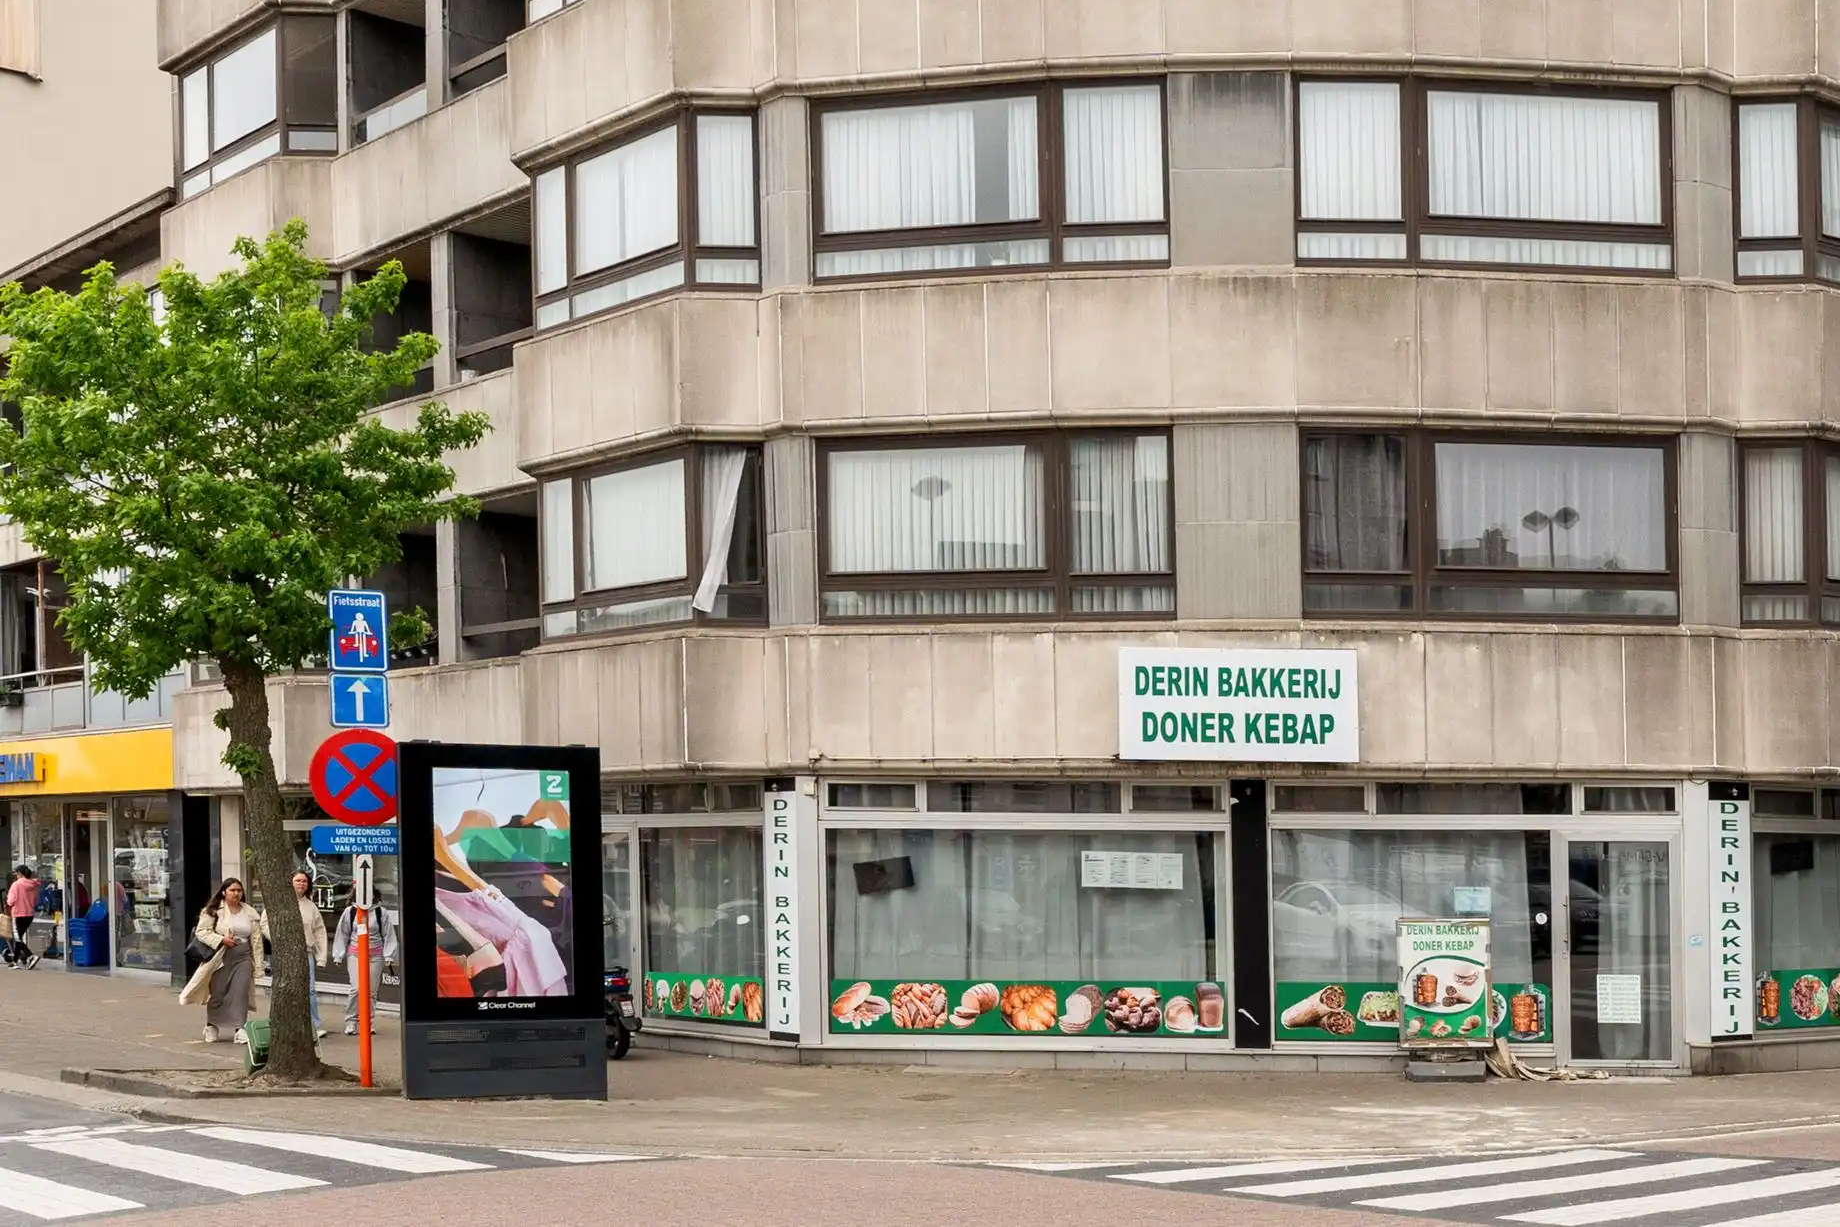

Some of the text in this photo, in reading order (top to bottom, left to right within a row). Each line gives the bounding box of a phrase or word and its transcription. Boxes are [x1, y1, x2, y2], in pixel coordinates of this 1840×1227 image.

[333, 596, 381, 607] Fietsstraat
[1135, 666, 1341, 700] DERIN BAKKERIJ
[1142, 711, 1335, 745] DONER KEBAP
[335, 828, 391, 836] UITGEZONDERD
[330, 836, 356, 844] LADEN
[773, 798, 792, 1025] DERIN BAKKERIJ
[1720, 802, 1742, 1034] DERIN BAKKERIJ
[1407, 925, 1480, 936] DERIN BAKKERIJ
[1412, 941, 1474, 951] DONER KEBAP
[507, 1001, 536, 1009] Channel
